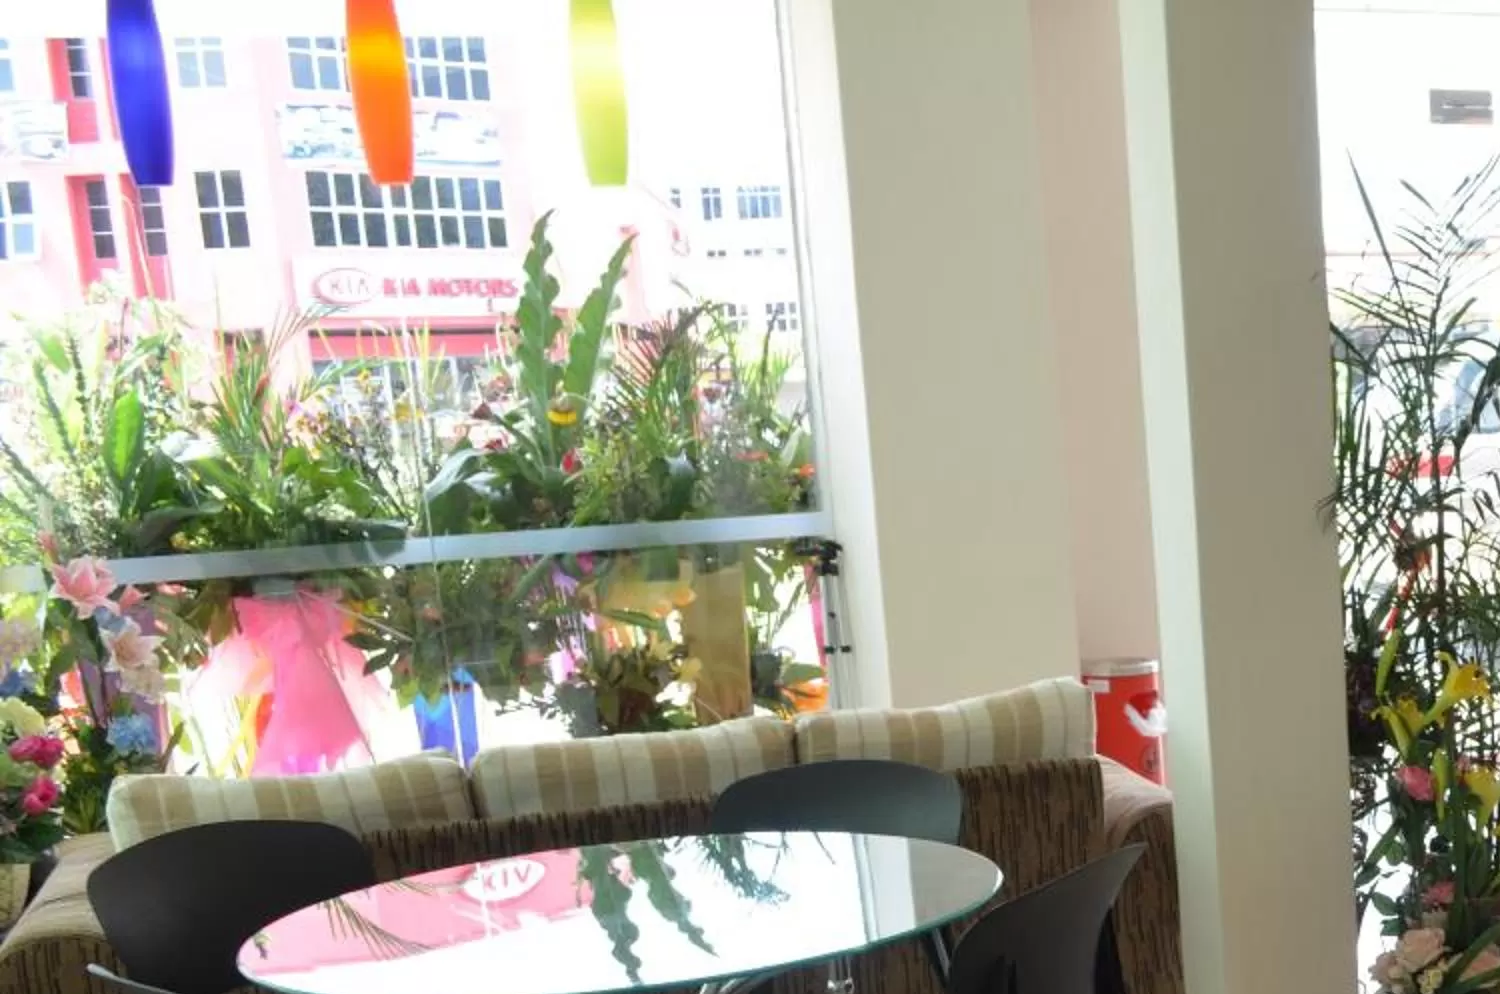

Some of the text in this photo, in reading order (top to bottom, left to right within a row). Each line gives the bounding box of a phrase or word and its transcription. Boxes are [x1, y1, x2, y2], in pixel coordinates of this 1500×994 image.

[329, 277, 370, 296] KIA
[382, 276, 519, 299] KIA MOTORS
